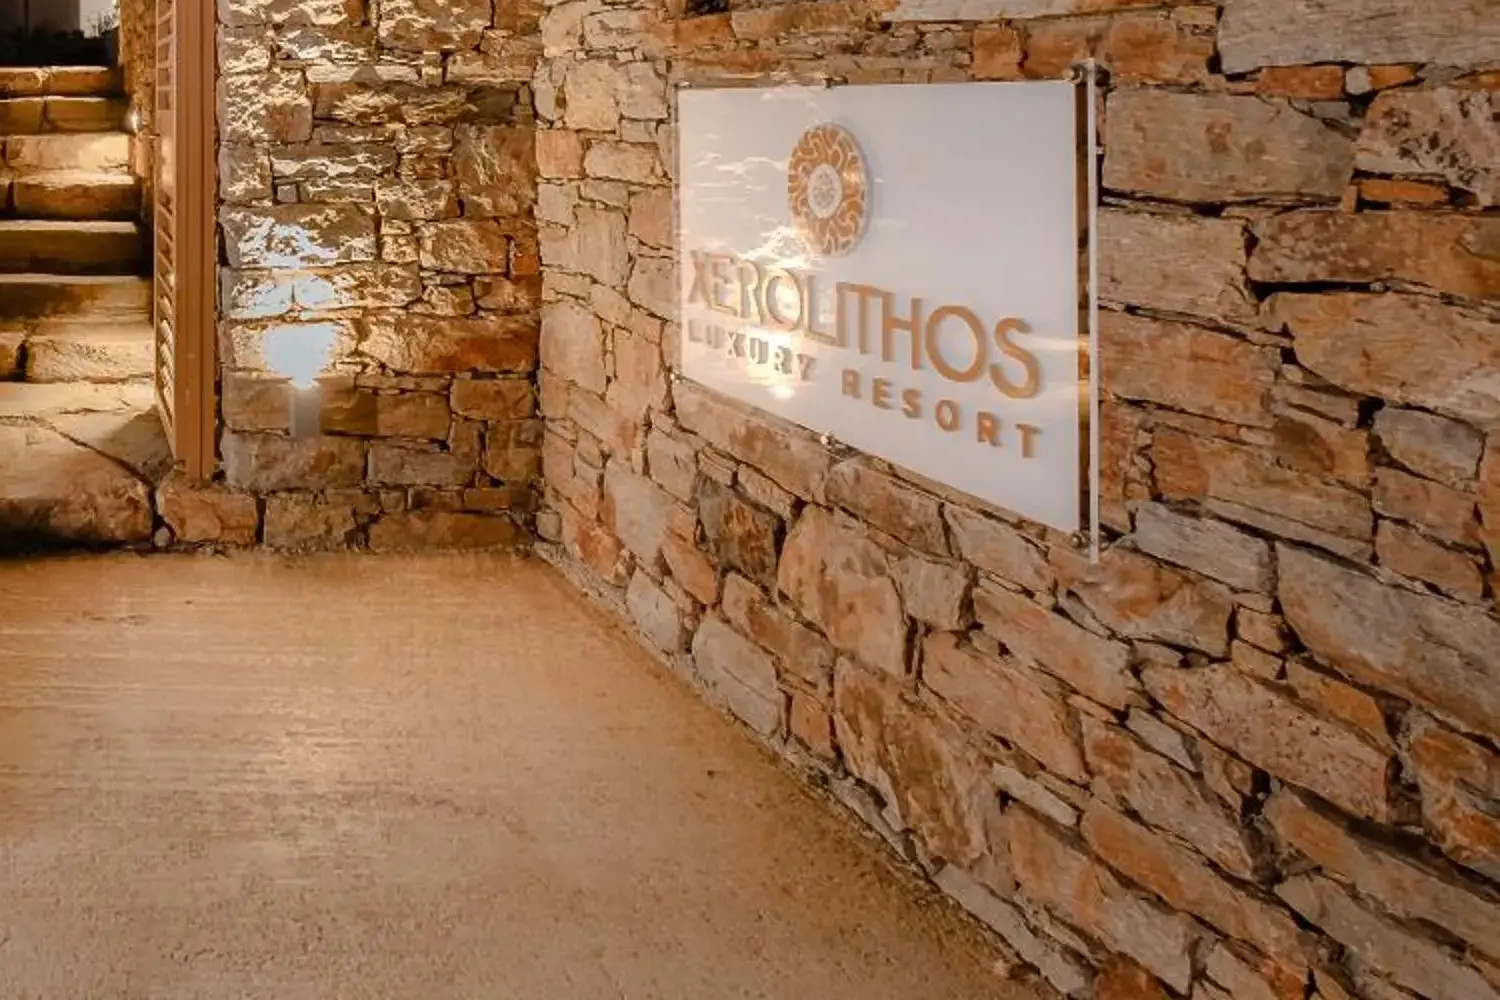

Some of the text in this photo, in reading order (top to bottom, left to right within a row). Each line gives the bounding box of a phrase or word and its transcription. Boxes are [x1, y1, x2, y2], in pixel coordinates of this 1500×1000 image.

[688, 250, 1041, 399] XEROLITHOS
[689, 319, 1041, 458] LUXURY RESORT
